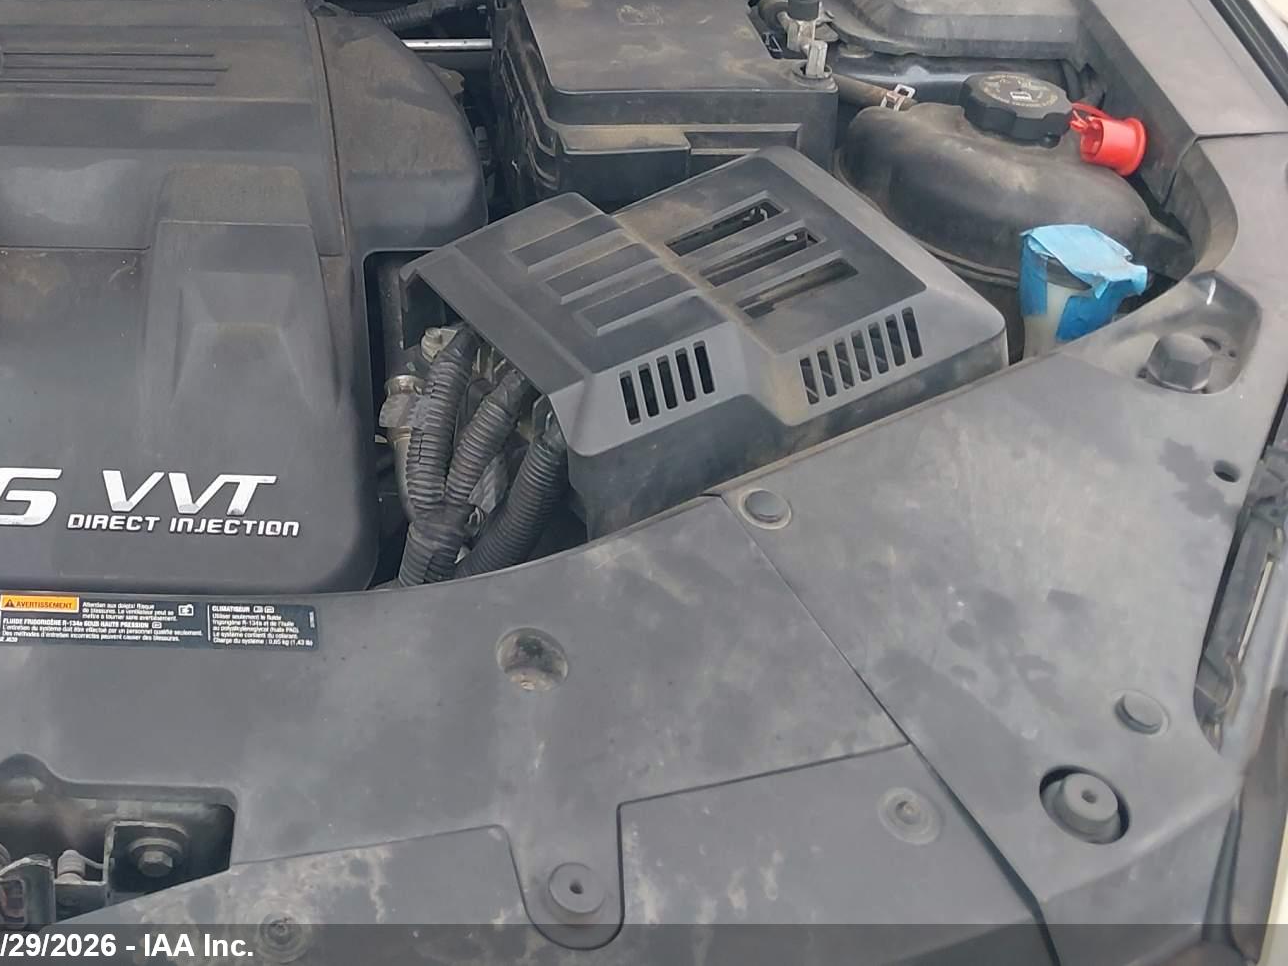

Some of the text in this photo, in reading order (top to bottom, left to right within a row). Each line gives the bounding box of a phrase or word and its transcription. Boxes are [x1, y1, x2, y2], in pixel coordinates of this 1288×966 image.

[102, 469, 277, 516] VVT
[67, 513, 300, 536] DIRECT INJECTION
